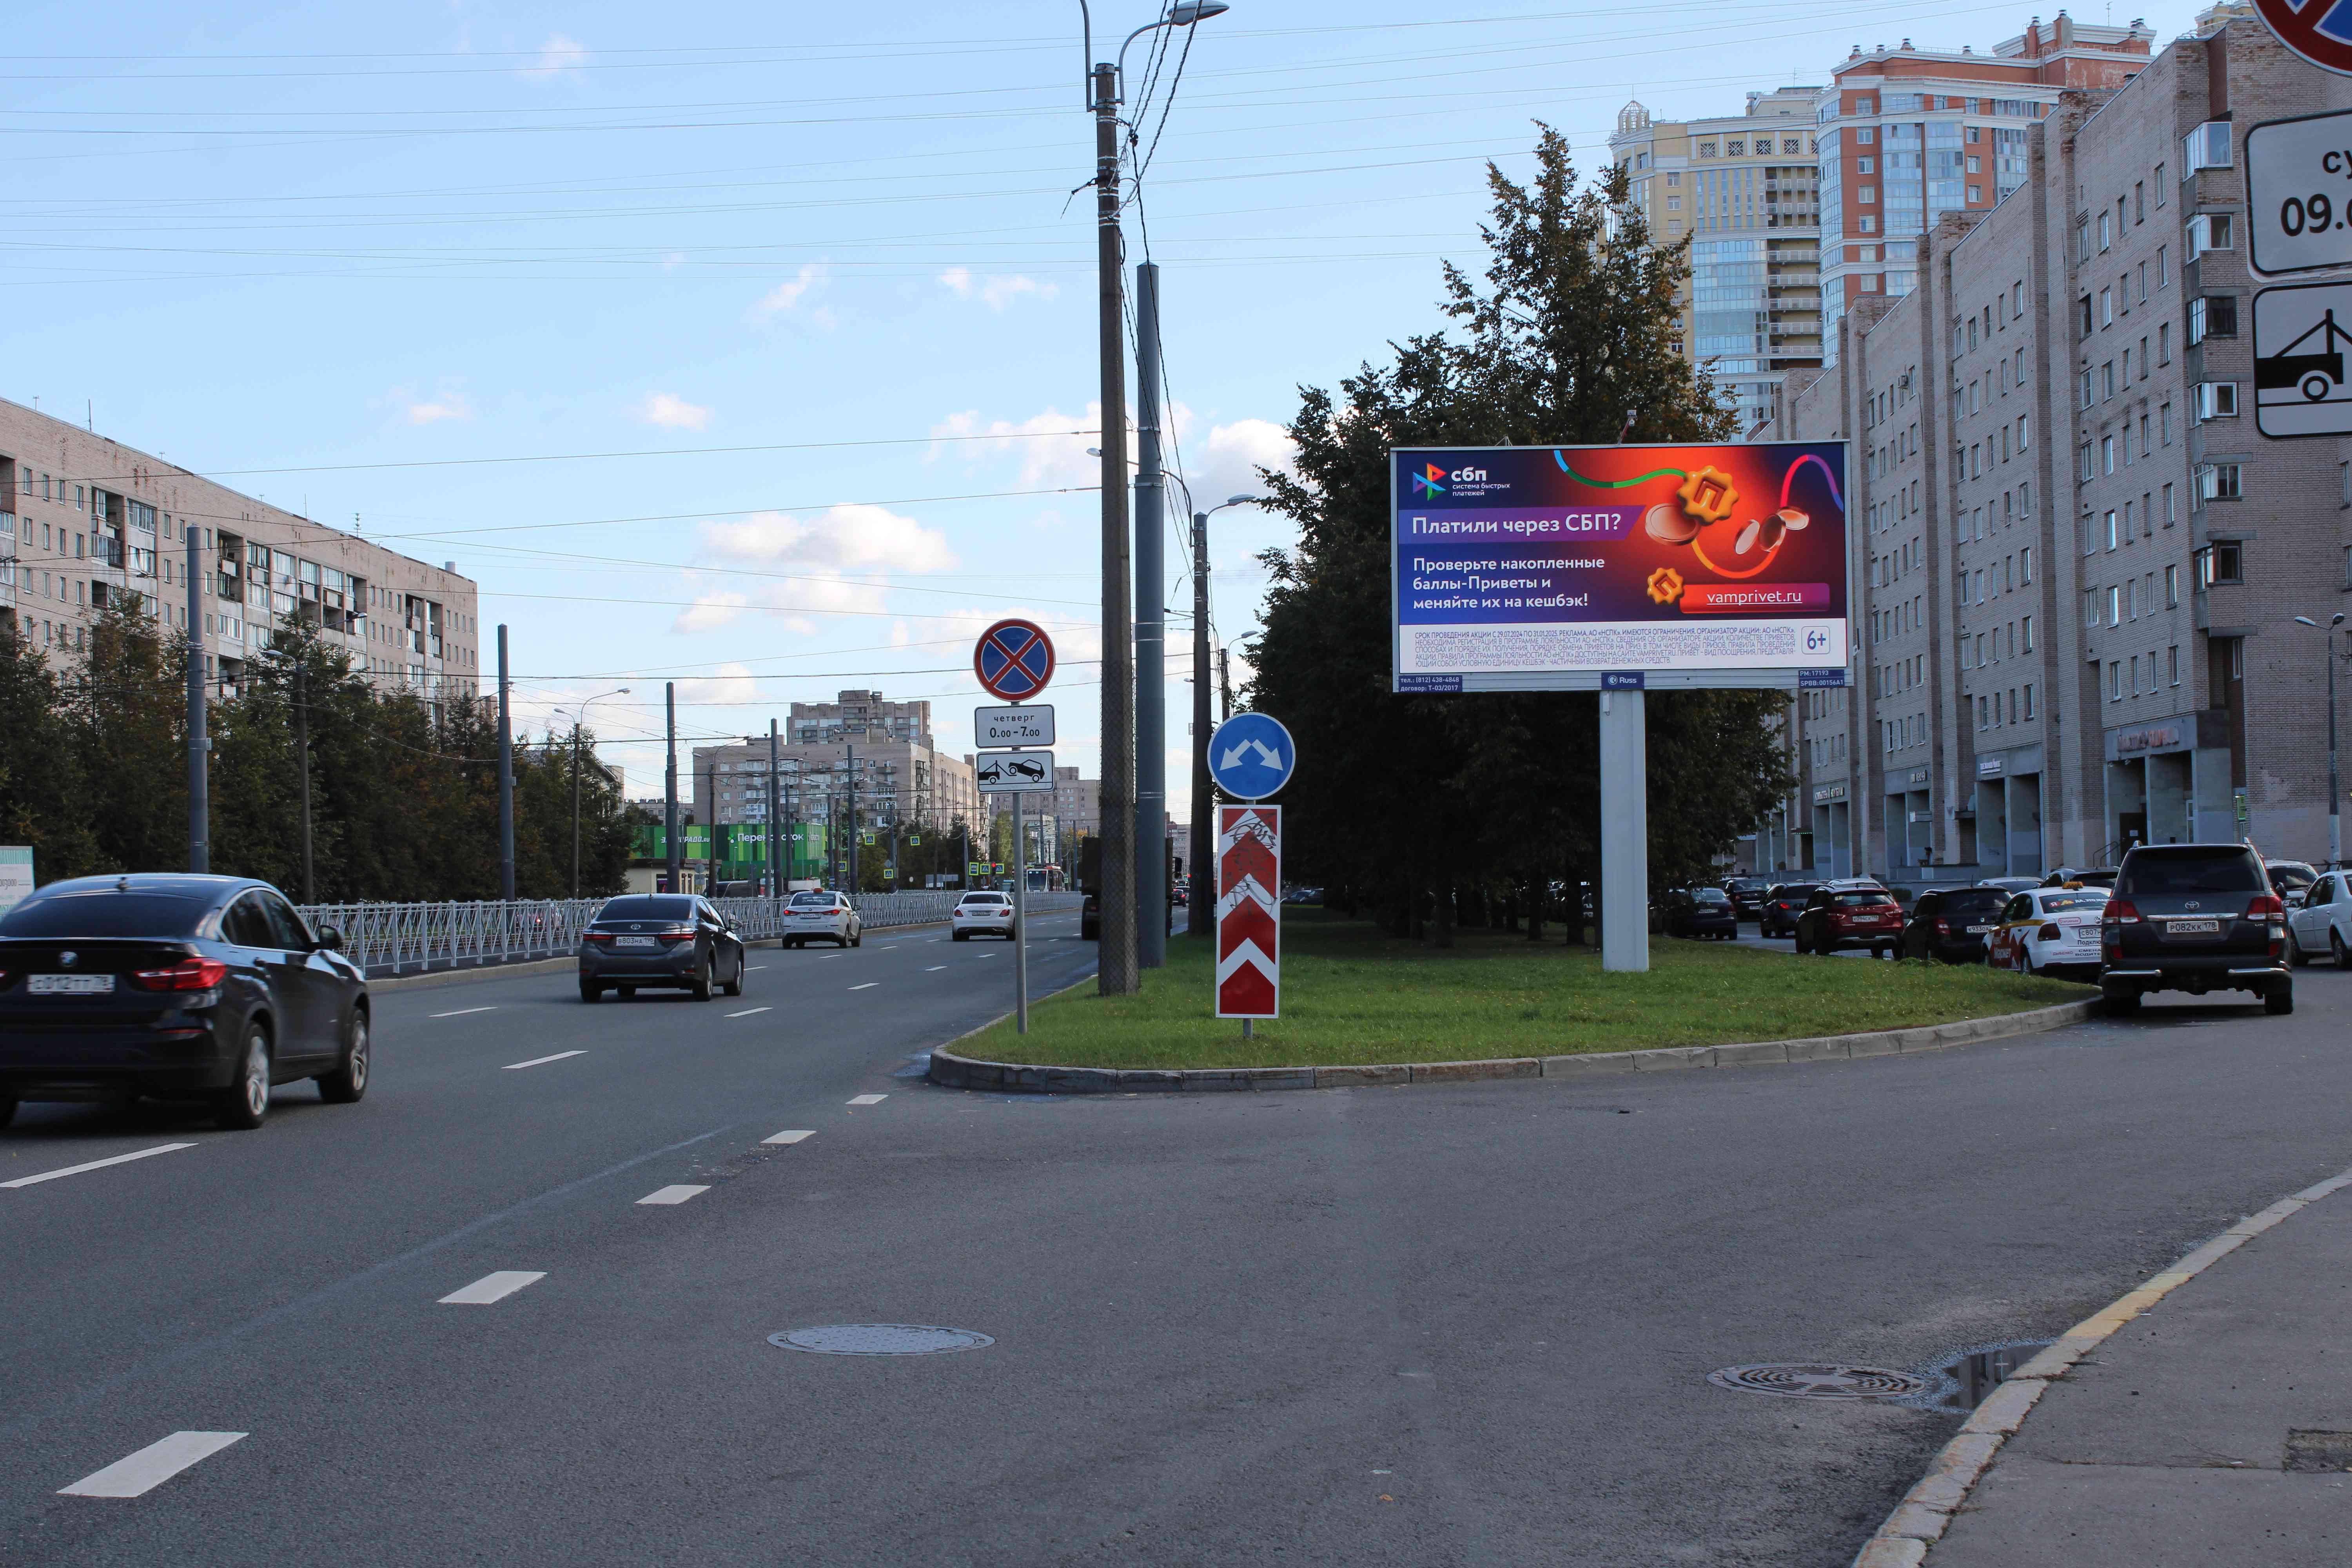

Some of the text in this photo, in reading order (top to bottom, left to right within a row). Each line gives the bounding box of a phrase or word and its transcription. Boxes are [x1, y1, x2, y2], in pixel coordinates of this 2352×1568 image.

[2281, 194, 2352, 236] 09.
[1451, 467, 1486, 481] сбп
[1412, 514, 1621, 536] Платили через СБП?
[1414, 557, 1605, 573] Проверьте накопленные
[1413, 576, 1550, 592] баллы-Приветы и
[1414, 593, 1588, 609] меняйте их на кешбэк!
[1707, 590, 1802, 606] vamprivet.ru
[1807, 630, 1826, 650] 6+
[994, 714, 1035, 723] четверг
[2170, 923, 2201, 931] Р082КК
